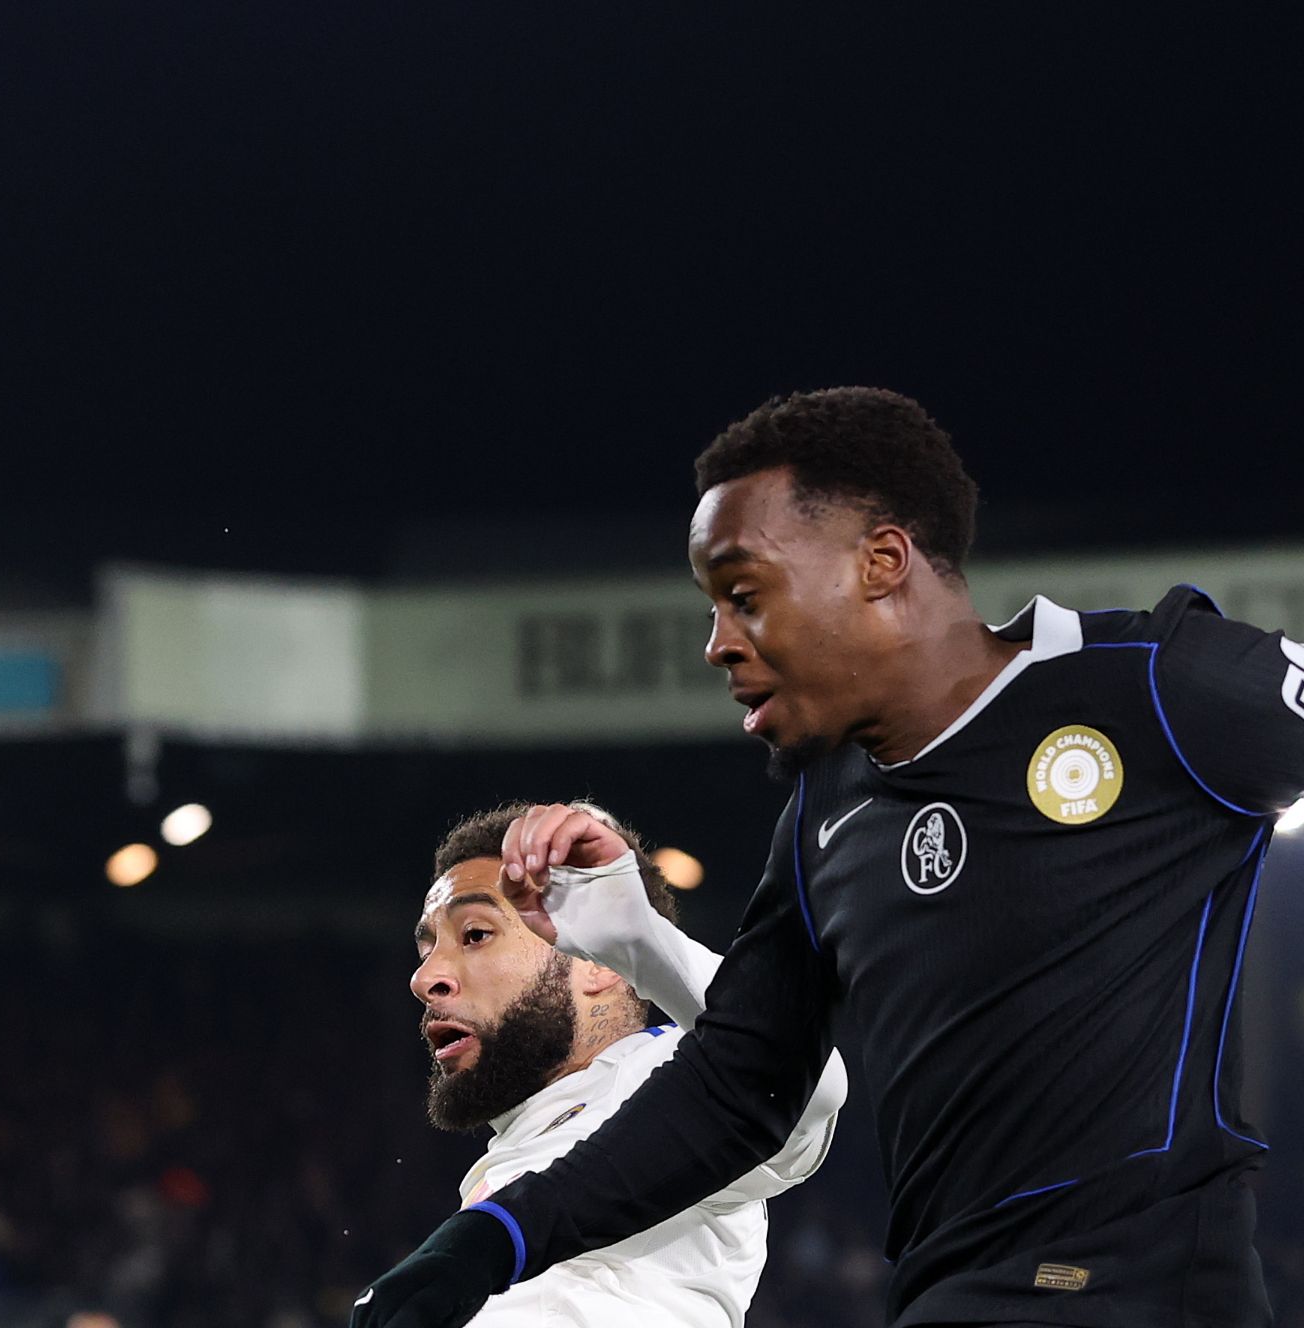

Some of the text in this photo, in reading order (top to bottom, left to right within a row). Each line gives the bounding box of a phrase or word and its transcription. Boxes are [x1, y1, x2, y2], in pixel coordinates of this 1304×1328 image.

[1036, 734, 1114, 793] WORLD CHAMPIONS
[1059, 799, 1099, 818] FIFA
